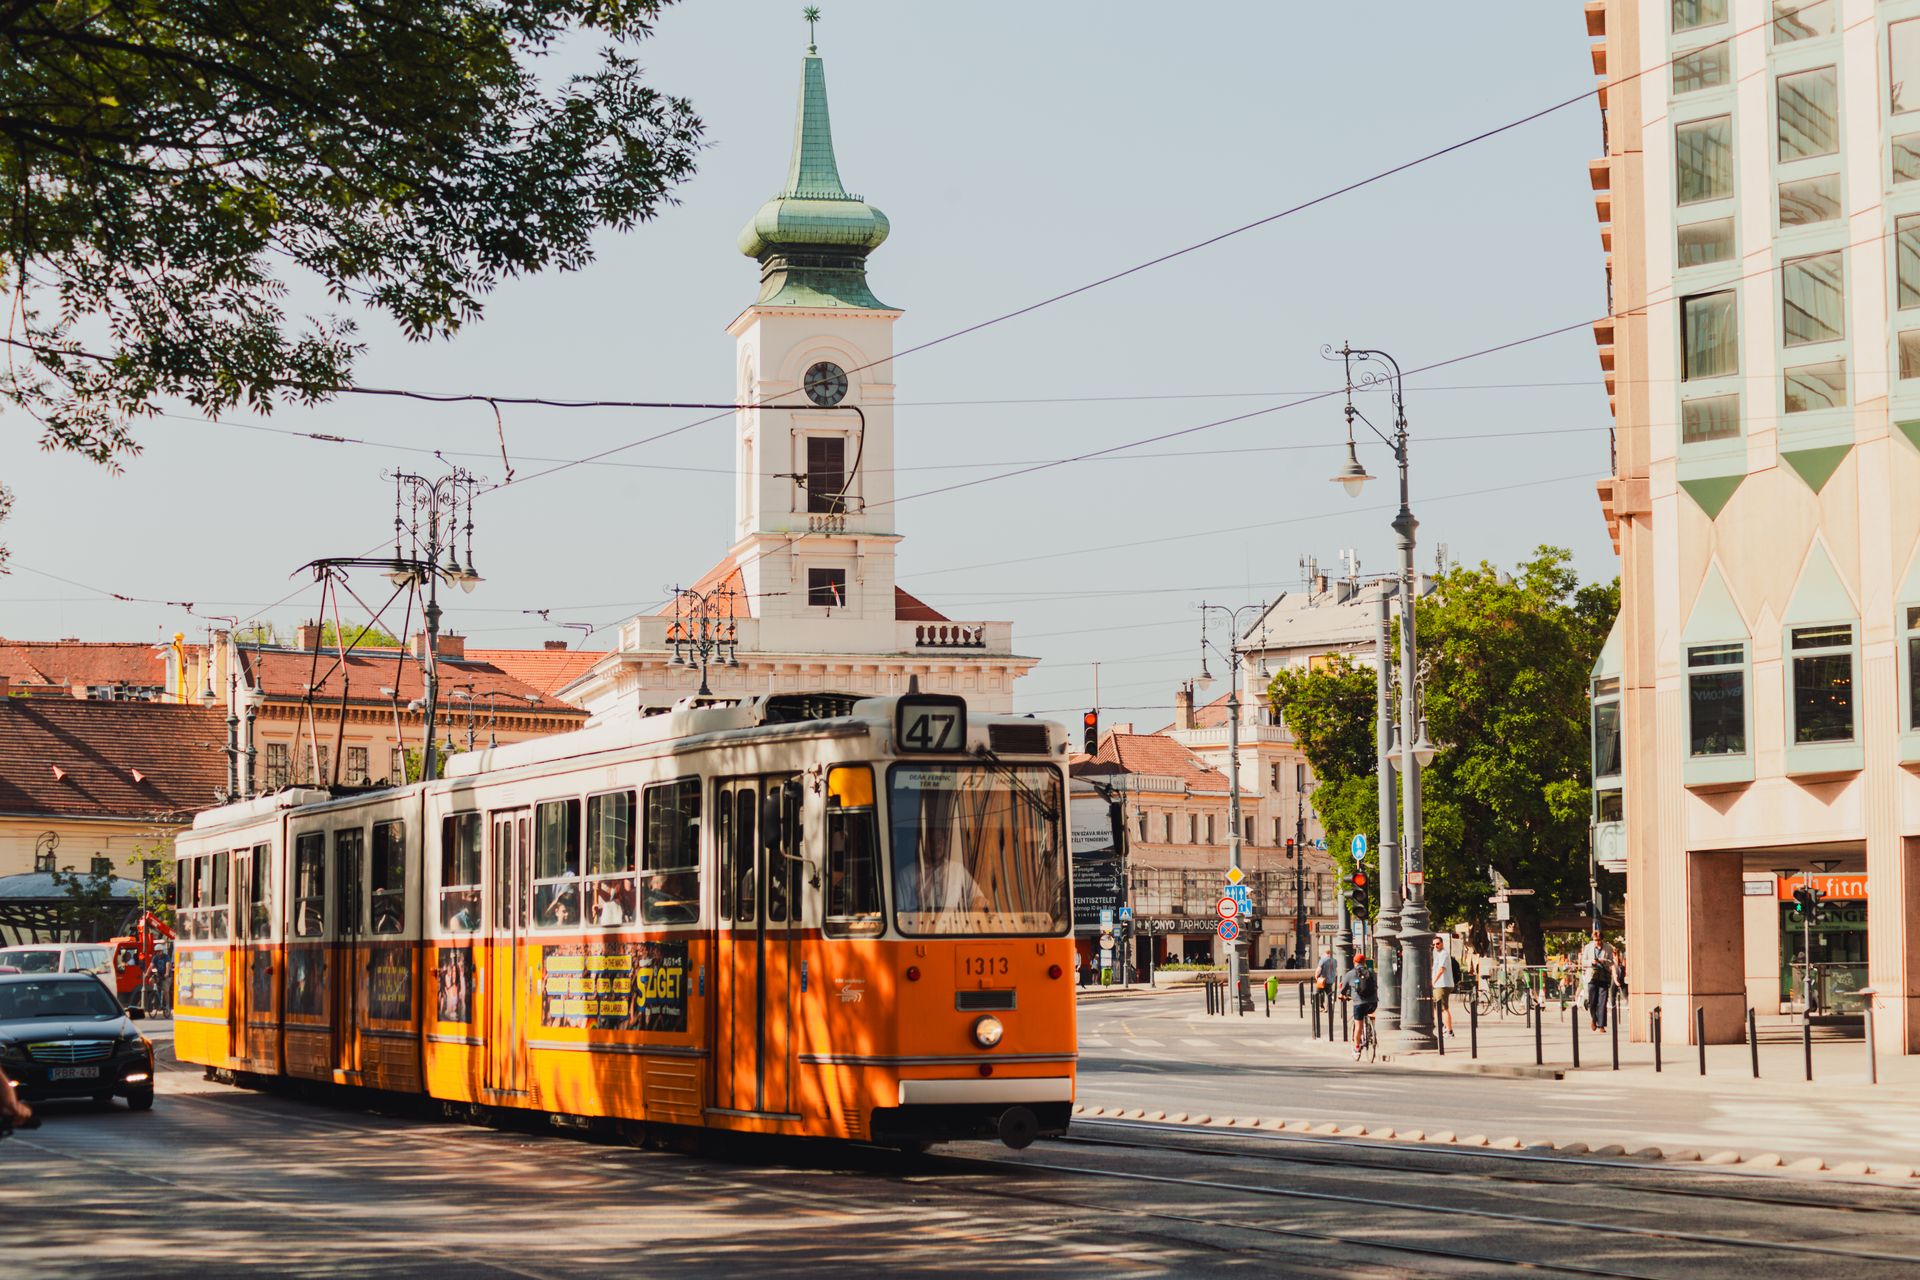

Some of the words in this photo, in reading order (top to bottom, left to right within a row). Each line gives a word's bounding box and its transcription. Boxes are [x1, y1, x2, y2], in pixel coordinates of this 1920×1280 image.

[906, 714, 955, 750] 47
[927, 774, 951, 783] FERENC
[963, 776, 986, 788] 47
[965, 957, 1009, 976] 1313
